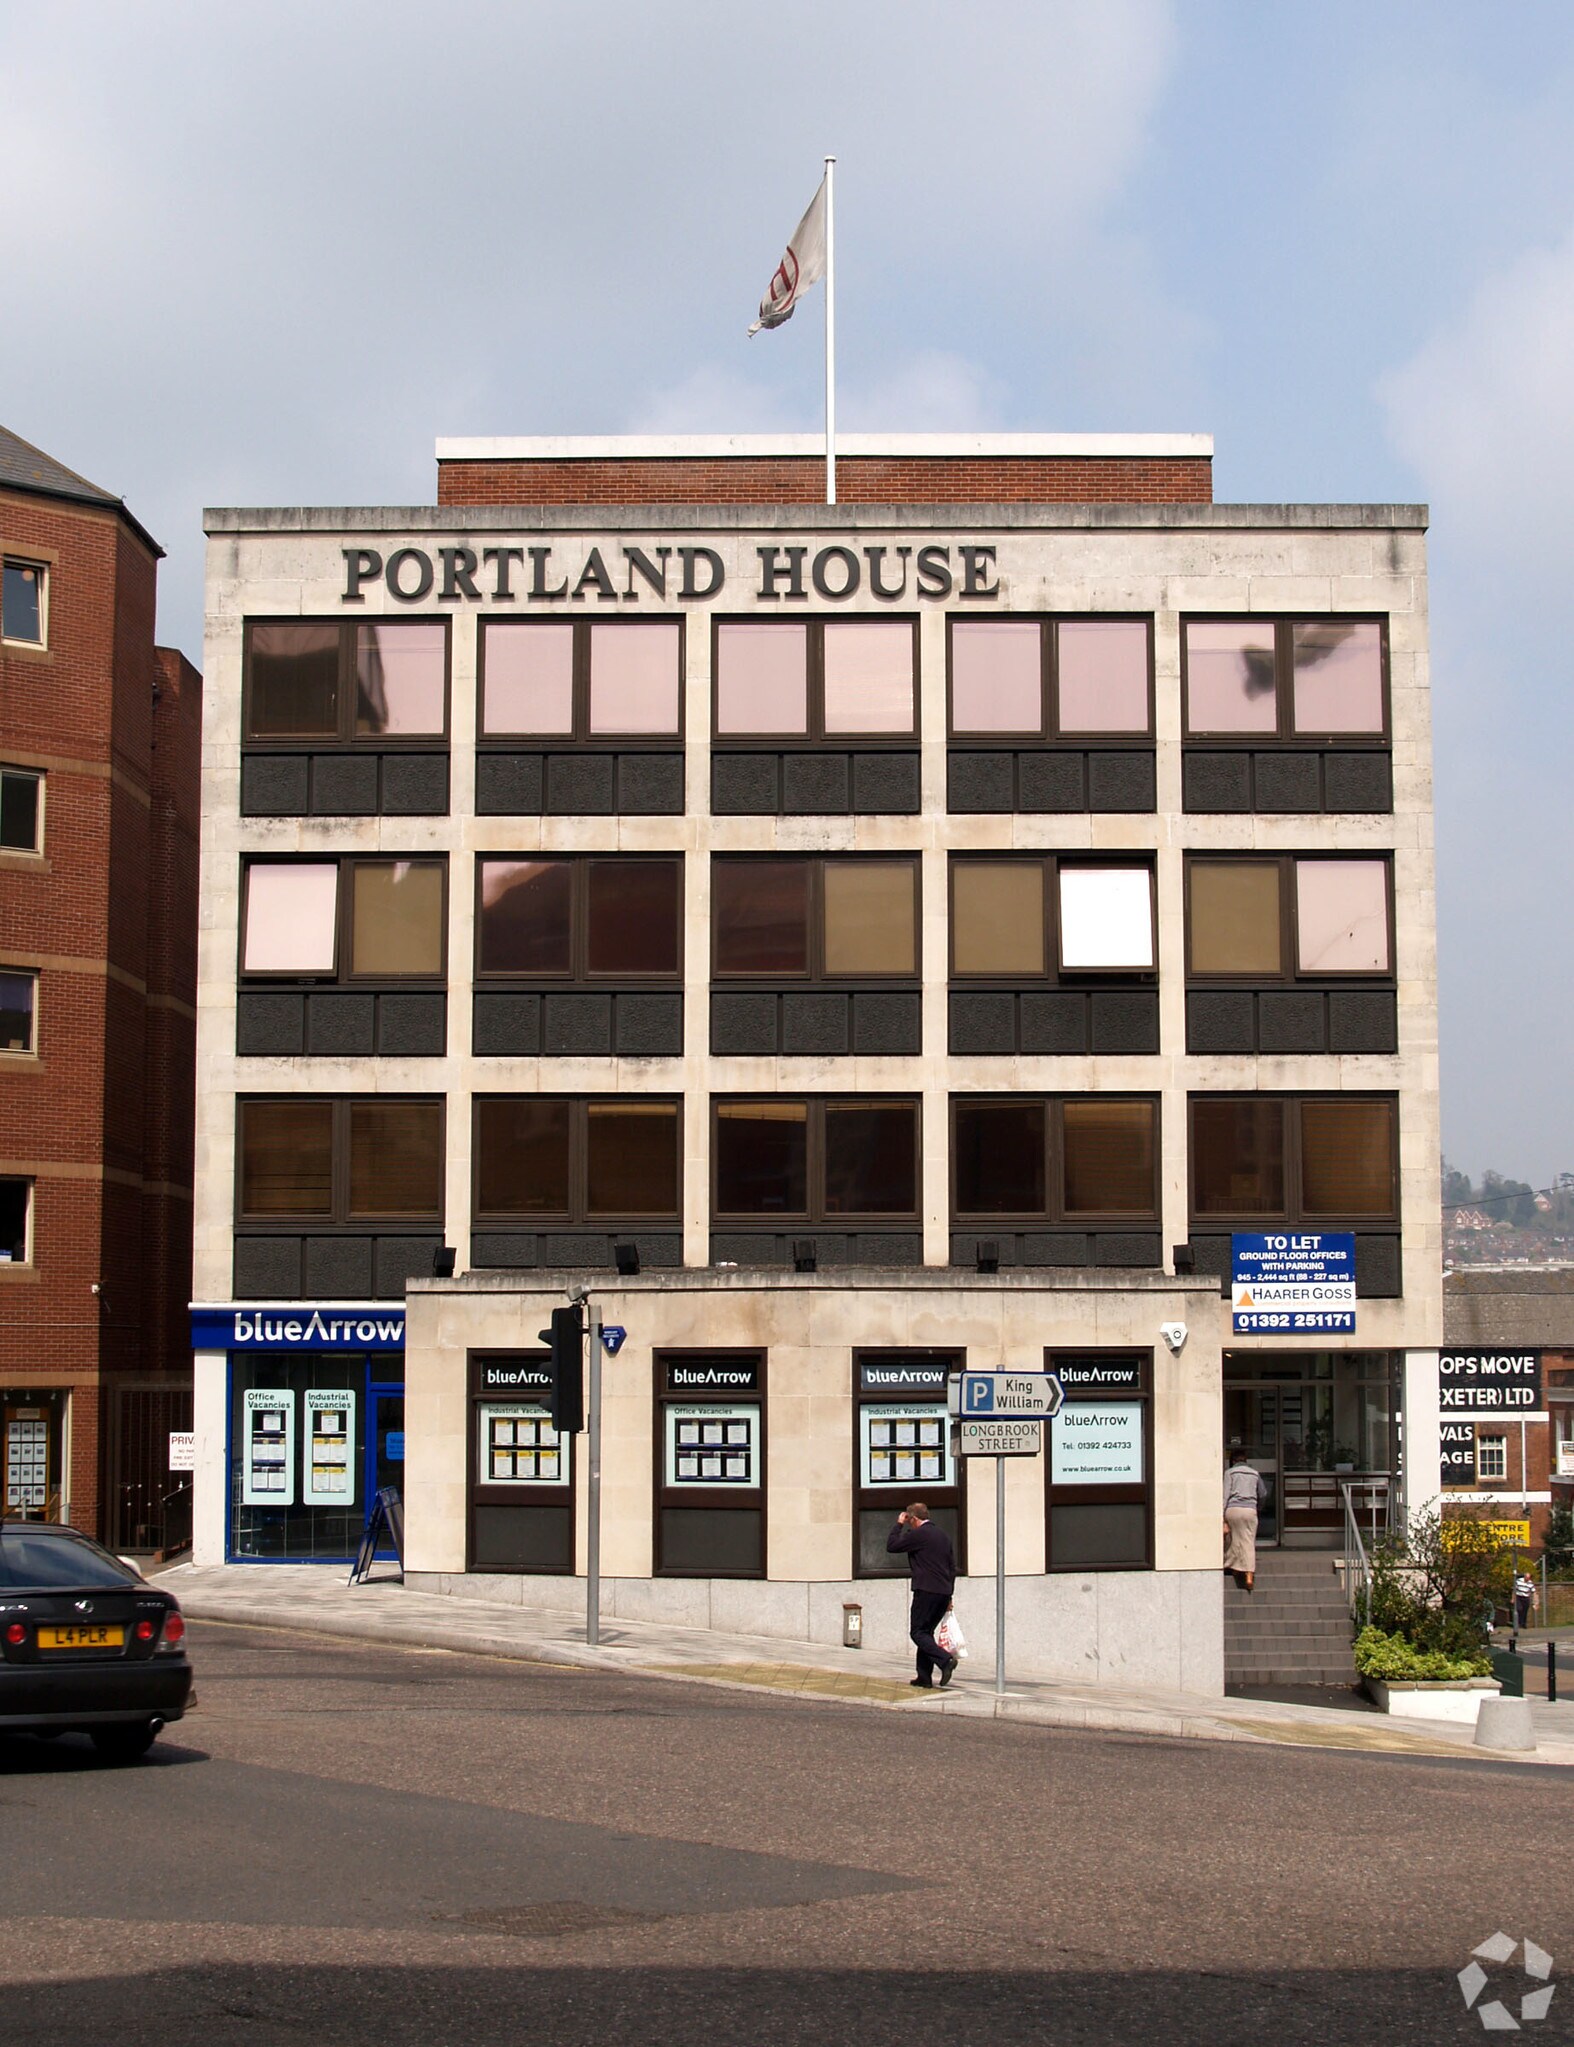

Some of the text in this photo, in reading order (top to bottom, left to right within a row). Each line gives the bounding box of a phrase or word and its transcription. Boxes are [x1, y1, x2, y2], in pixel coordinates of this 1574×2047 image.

[341, 545, 1000, 602] PORTLAND HOUSE
[1264, 1236, 1321, 1249] TO LET
[1239, 1251, 1347, 1260] GROUND FLOOR OFFICES
[1262, 1262, 1324, 1270] WITH PARKING
[1328, 1274, 1338, 1282] sq
[1339, 1273, 1349, 1281] m)
[1252, 1287, 1352, 1299] HAARER GOSS
[234, 1310, 404, 1342] blueArrow
[1238, 1313, 1351, 1327] 01392 251171
[1480, 1356, 1535, 1374] MOVE
[487, 1368, 553, 1384] blueArro
[674, 1368, 752, 1383] blueArrow
[866, 1368, 944, 1383] blueArrow
[1060, 1367, 1134, 1382] blueArrow
[1006, 1379, 1033, 1394] King
[973, 1382, 988, 1407] P
[1439, 1387, 1535, 1407] XETER) LTD
[996, 1395, 1043, 1408] William
[1064, 1414, 1129, 1426] blueArrow
[963, 1424, 1039, 1437] LONGBROOK
[171, 1436, 195, 1445] PRIV
[978, 1438, 1023, 1450] STREET
[1077, 1442, 1100, 1450] 01392
[1102, 1441, 1132, 1449] 424733
[1062, 1465, 1131, 1473] www.bluearrow.co.uk
[55, 1627, 108, 1644] L4 PLR
